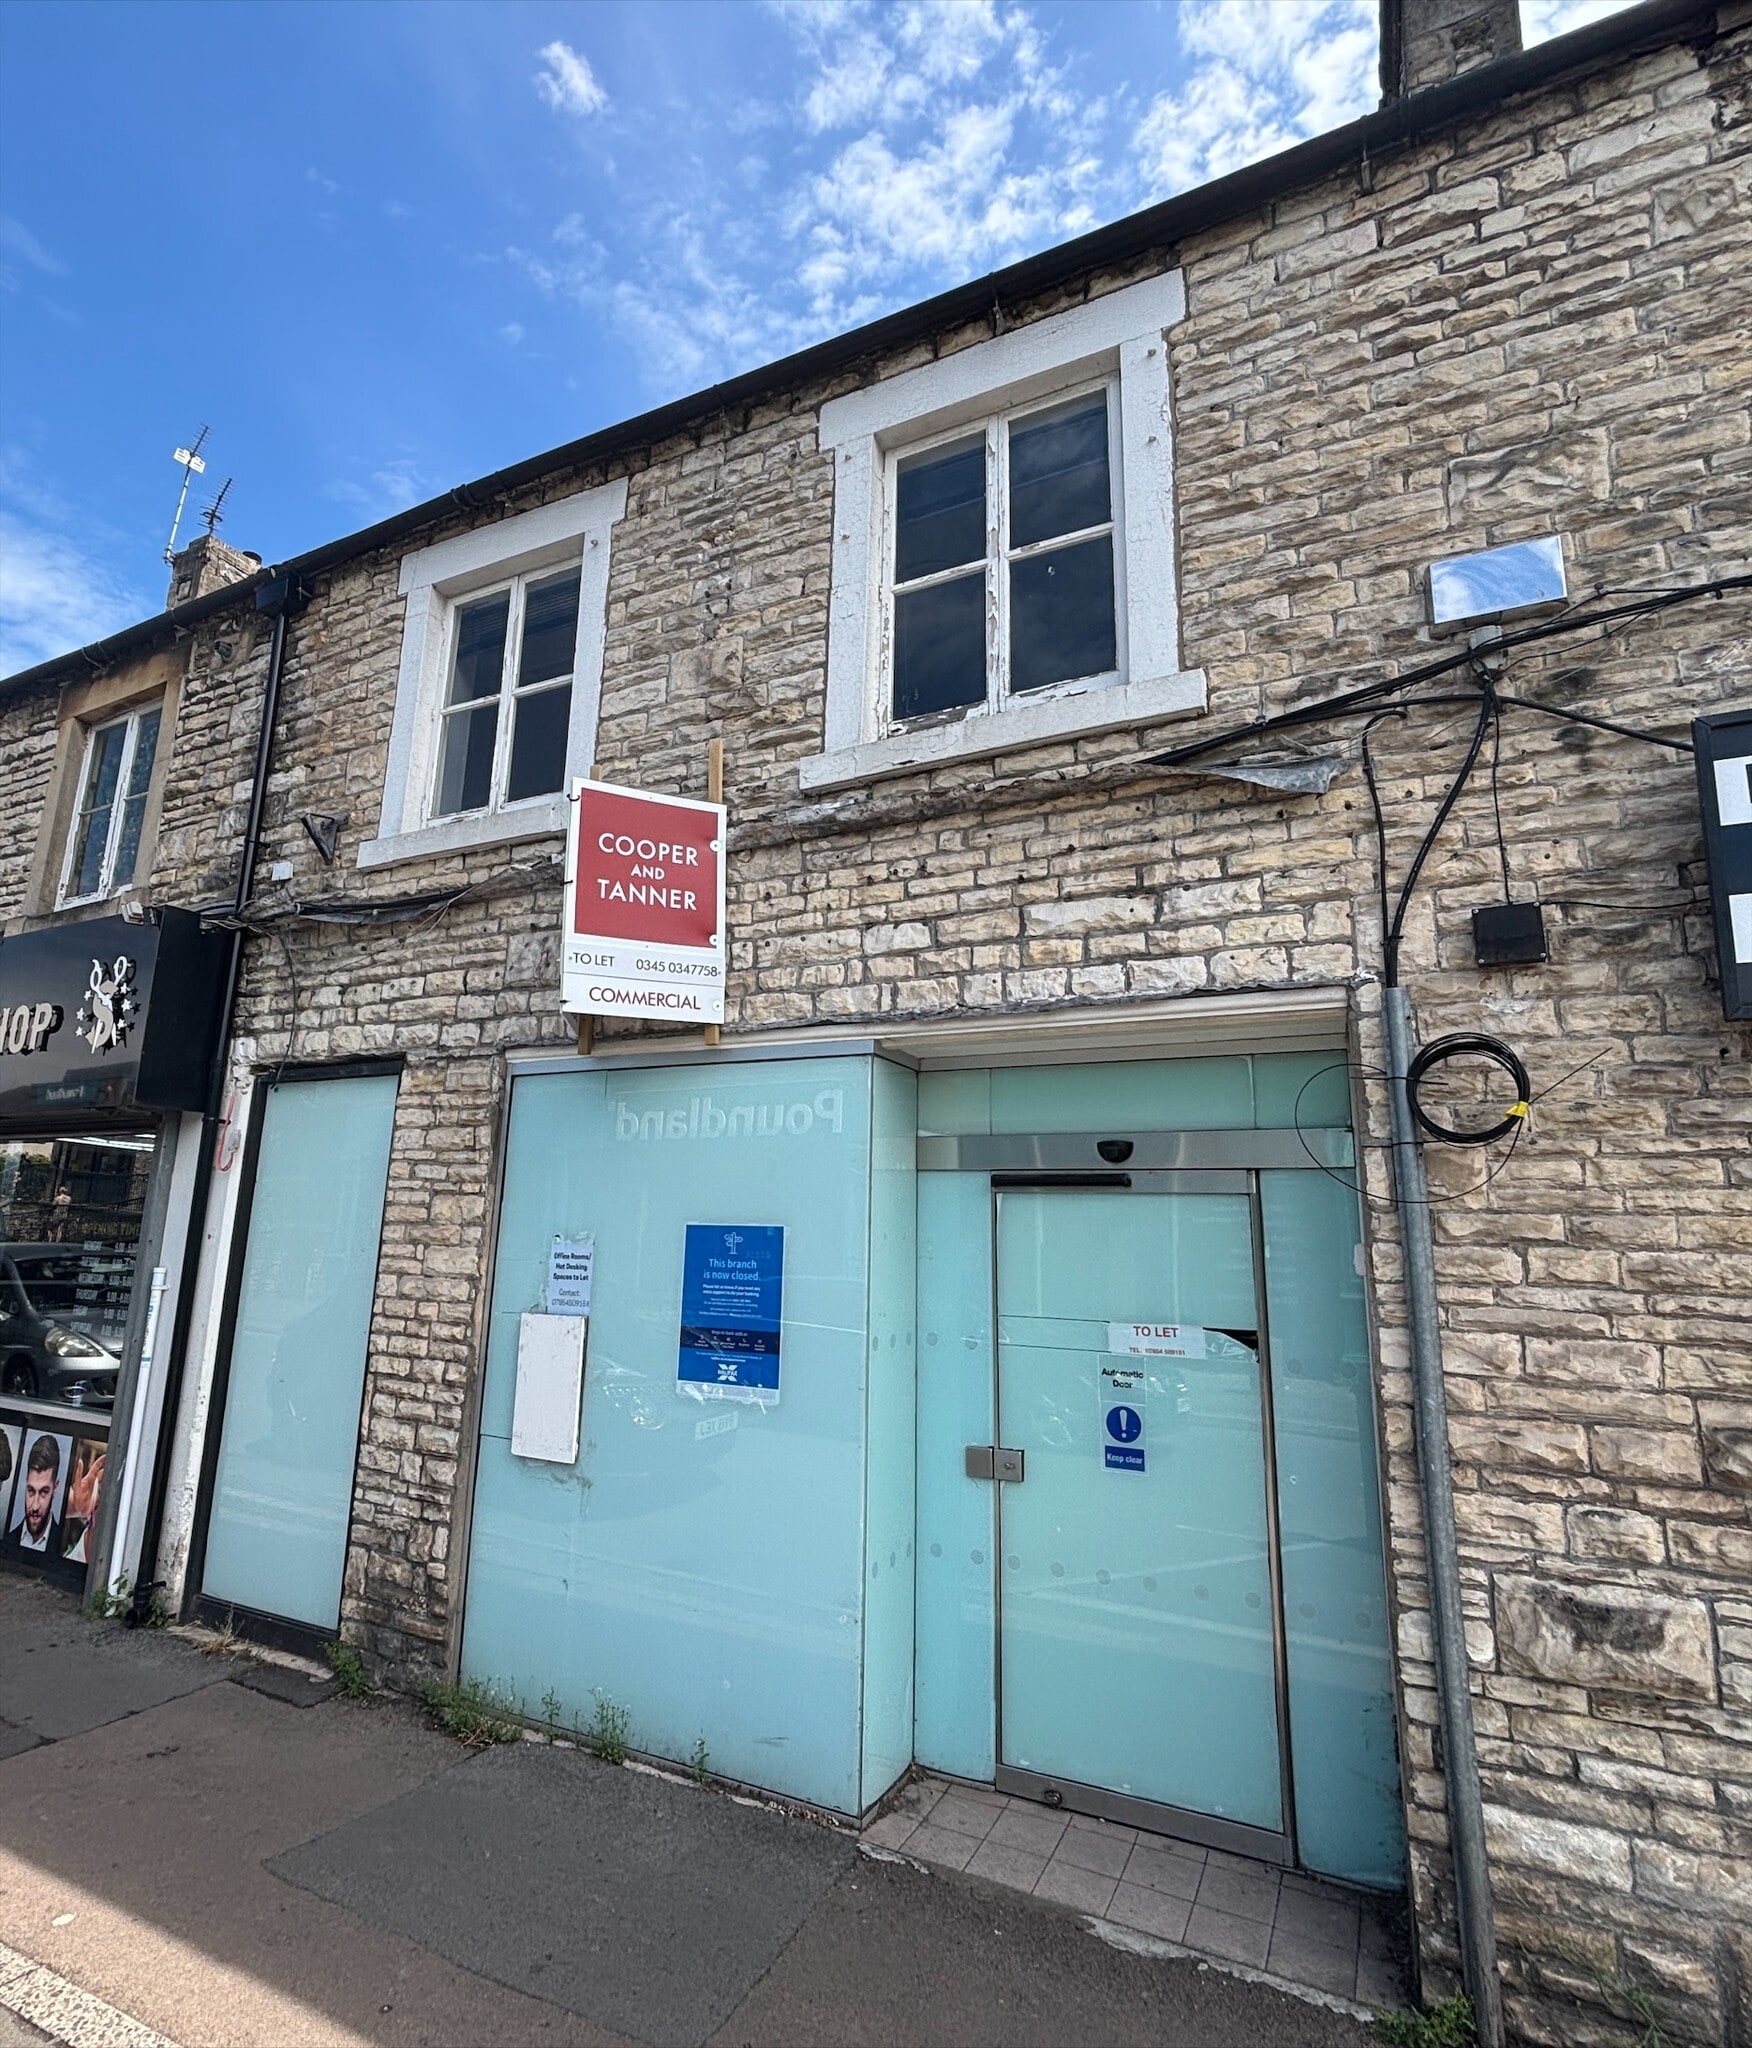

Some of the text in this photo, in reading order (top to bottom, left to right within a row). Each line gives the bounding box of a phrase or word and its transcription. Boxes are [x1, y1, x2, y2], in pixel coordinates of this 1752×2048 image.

[599, 833, 699, 866] COOPER
[631, 864, 665, 880] AND
[597, 879, 697, 910] TANNER
[573, 952, 718, 977] TO LET 0345 0347758
[589, 986, 701, 1010] COMMERCIAL
[0, 1003, 54, 1054] OP
[553, 1252, 570, 1260] Office
[708, 1258, 757, 1269] This branch
[553, 1273, 573, 1281] Spaces
[703, 1270, 761, 1281] is now closed.
[1133, 1326, 1179, 1338] TO LET
[1101, 1368, 1144, 1379] Automatic
[1112, 1380, 1133, 1389] Door
[1107, 1453, 1143, 1465] Keep clear
